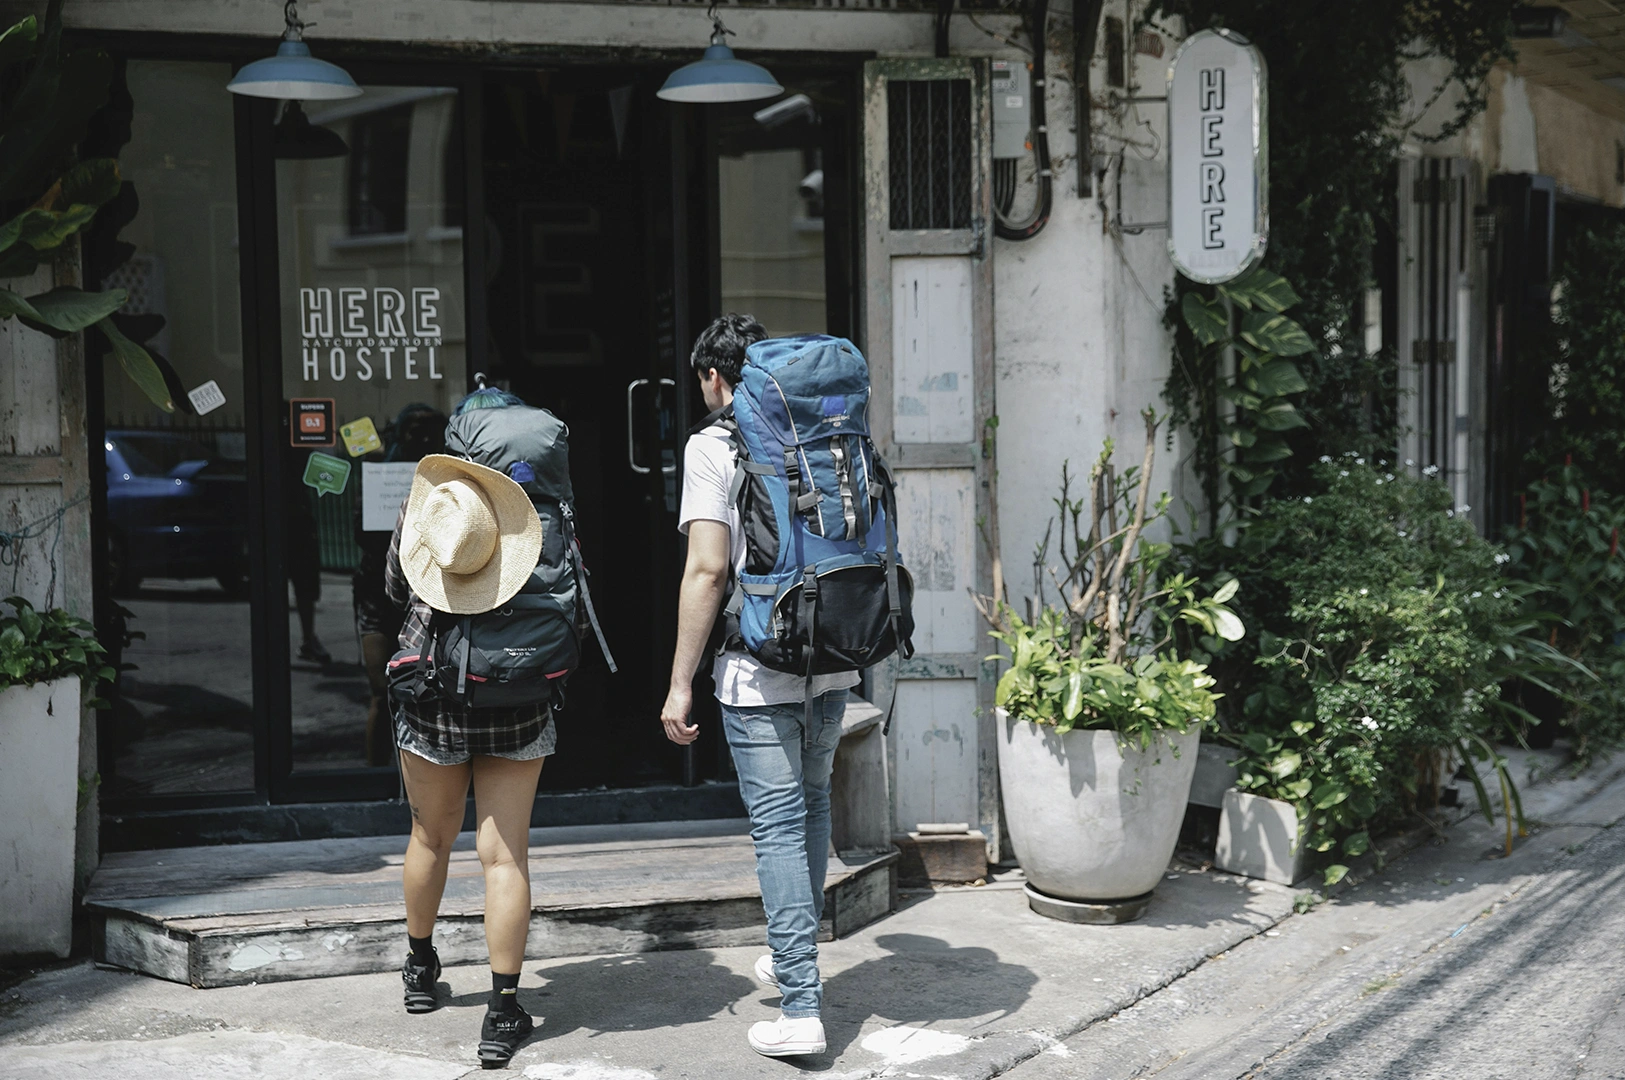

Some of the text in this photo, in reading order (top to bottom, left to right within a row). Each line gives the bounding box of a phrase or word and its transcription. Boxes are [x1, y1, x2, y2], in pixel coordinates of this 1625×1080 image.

[1200, 68, 1225, 249] HERE
[300, 287, 441, 338] HERE
[302, 338, 442, 347] RATCHADAMNOEN
[302, 347, 443, 381] HOSTEL
